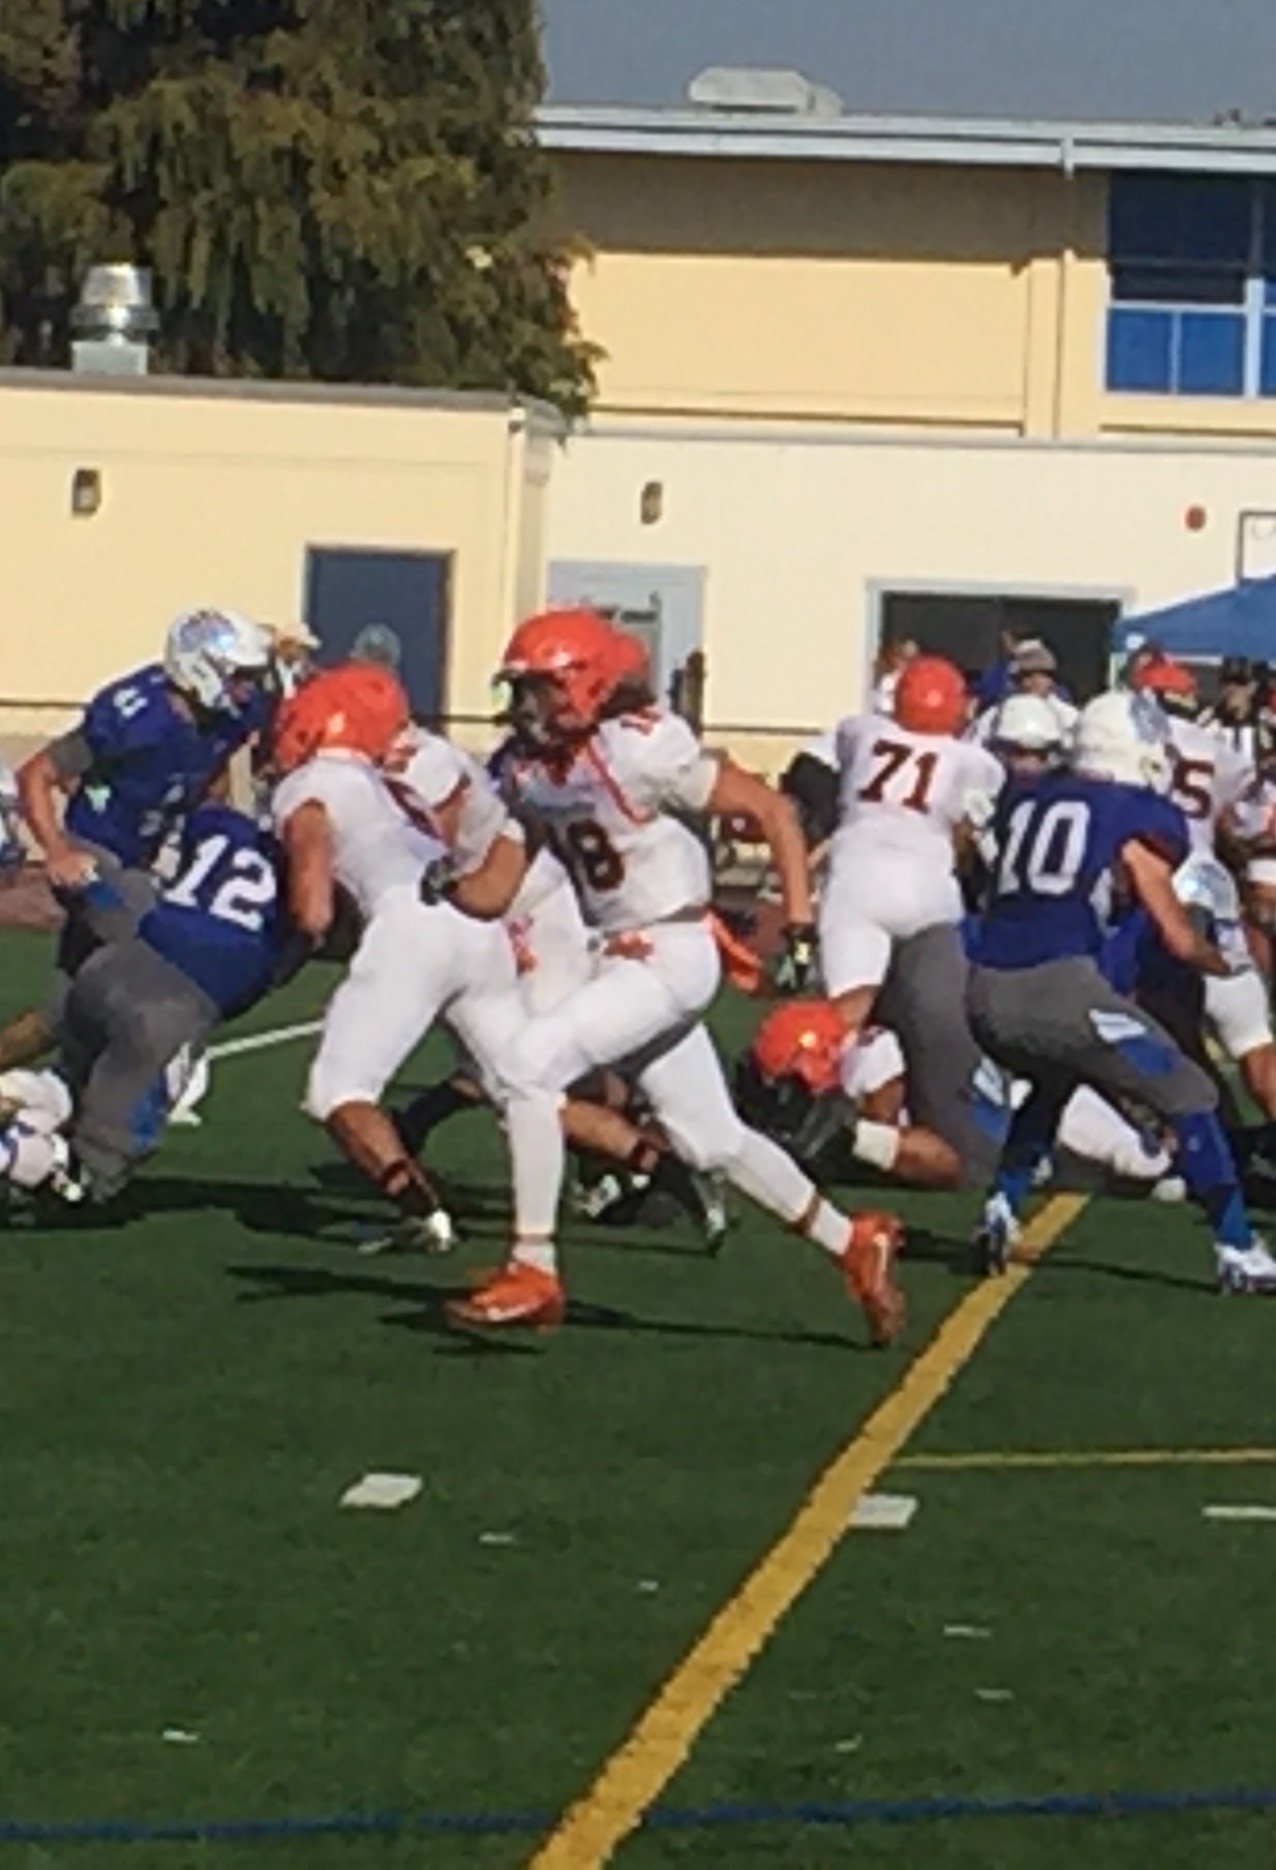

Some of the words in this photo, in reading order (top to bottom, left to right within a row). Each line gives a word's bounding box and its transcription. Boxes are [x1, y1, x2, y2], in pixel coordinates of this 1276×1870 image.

[858, 738, 938, 815] 71
[163, 834, 277, 932] 12
[999, 801, 1090, 895] 10
